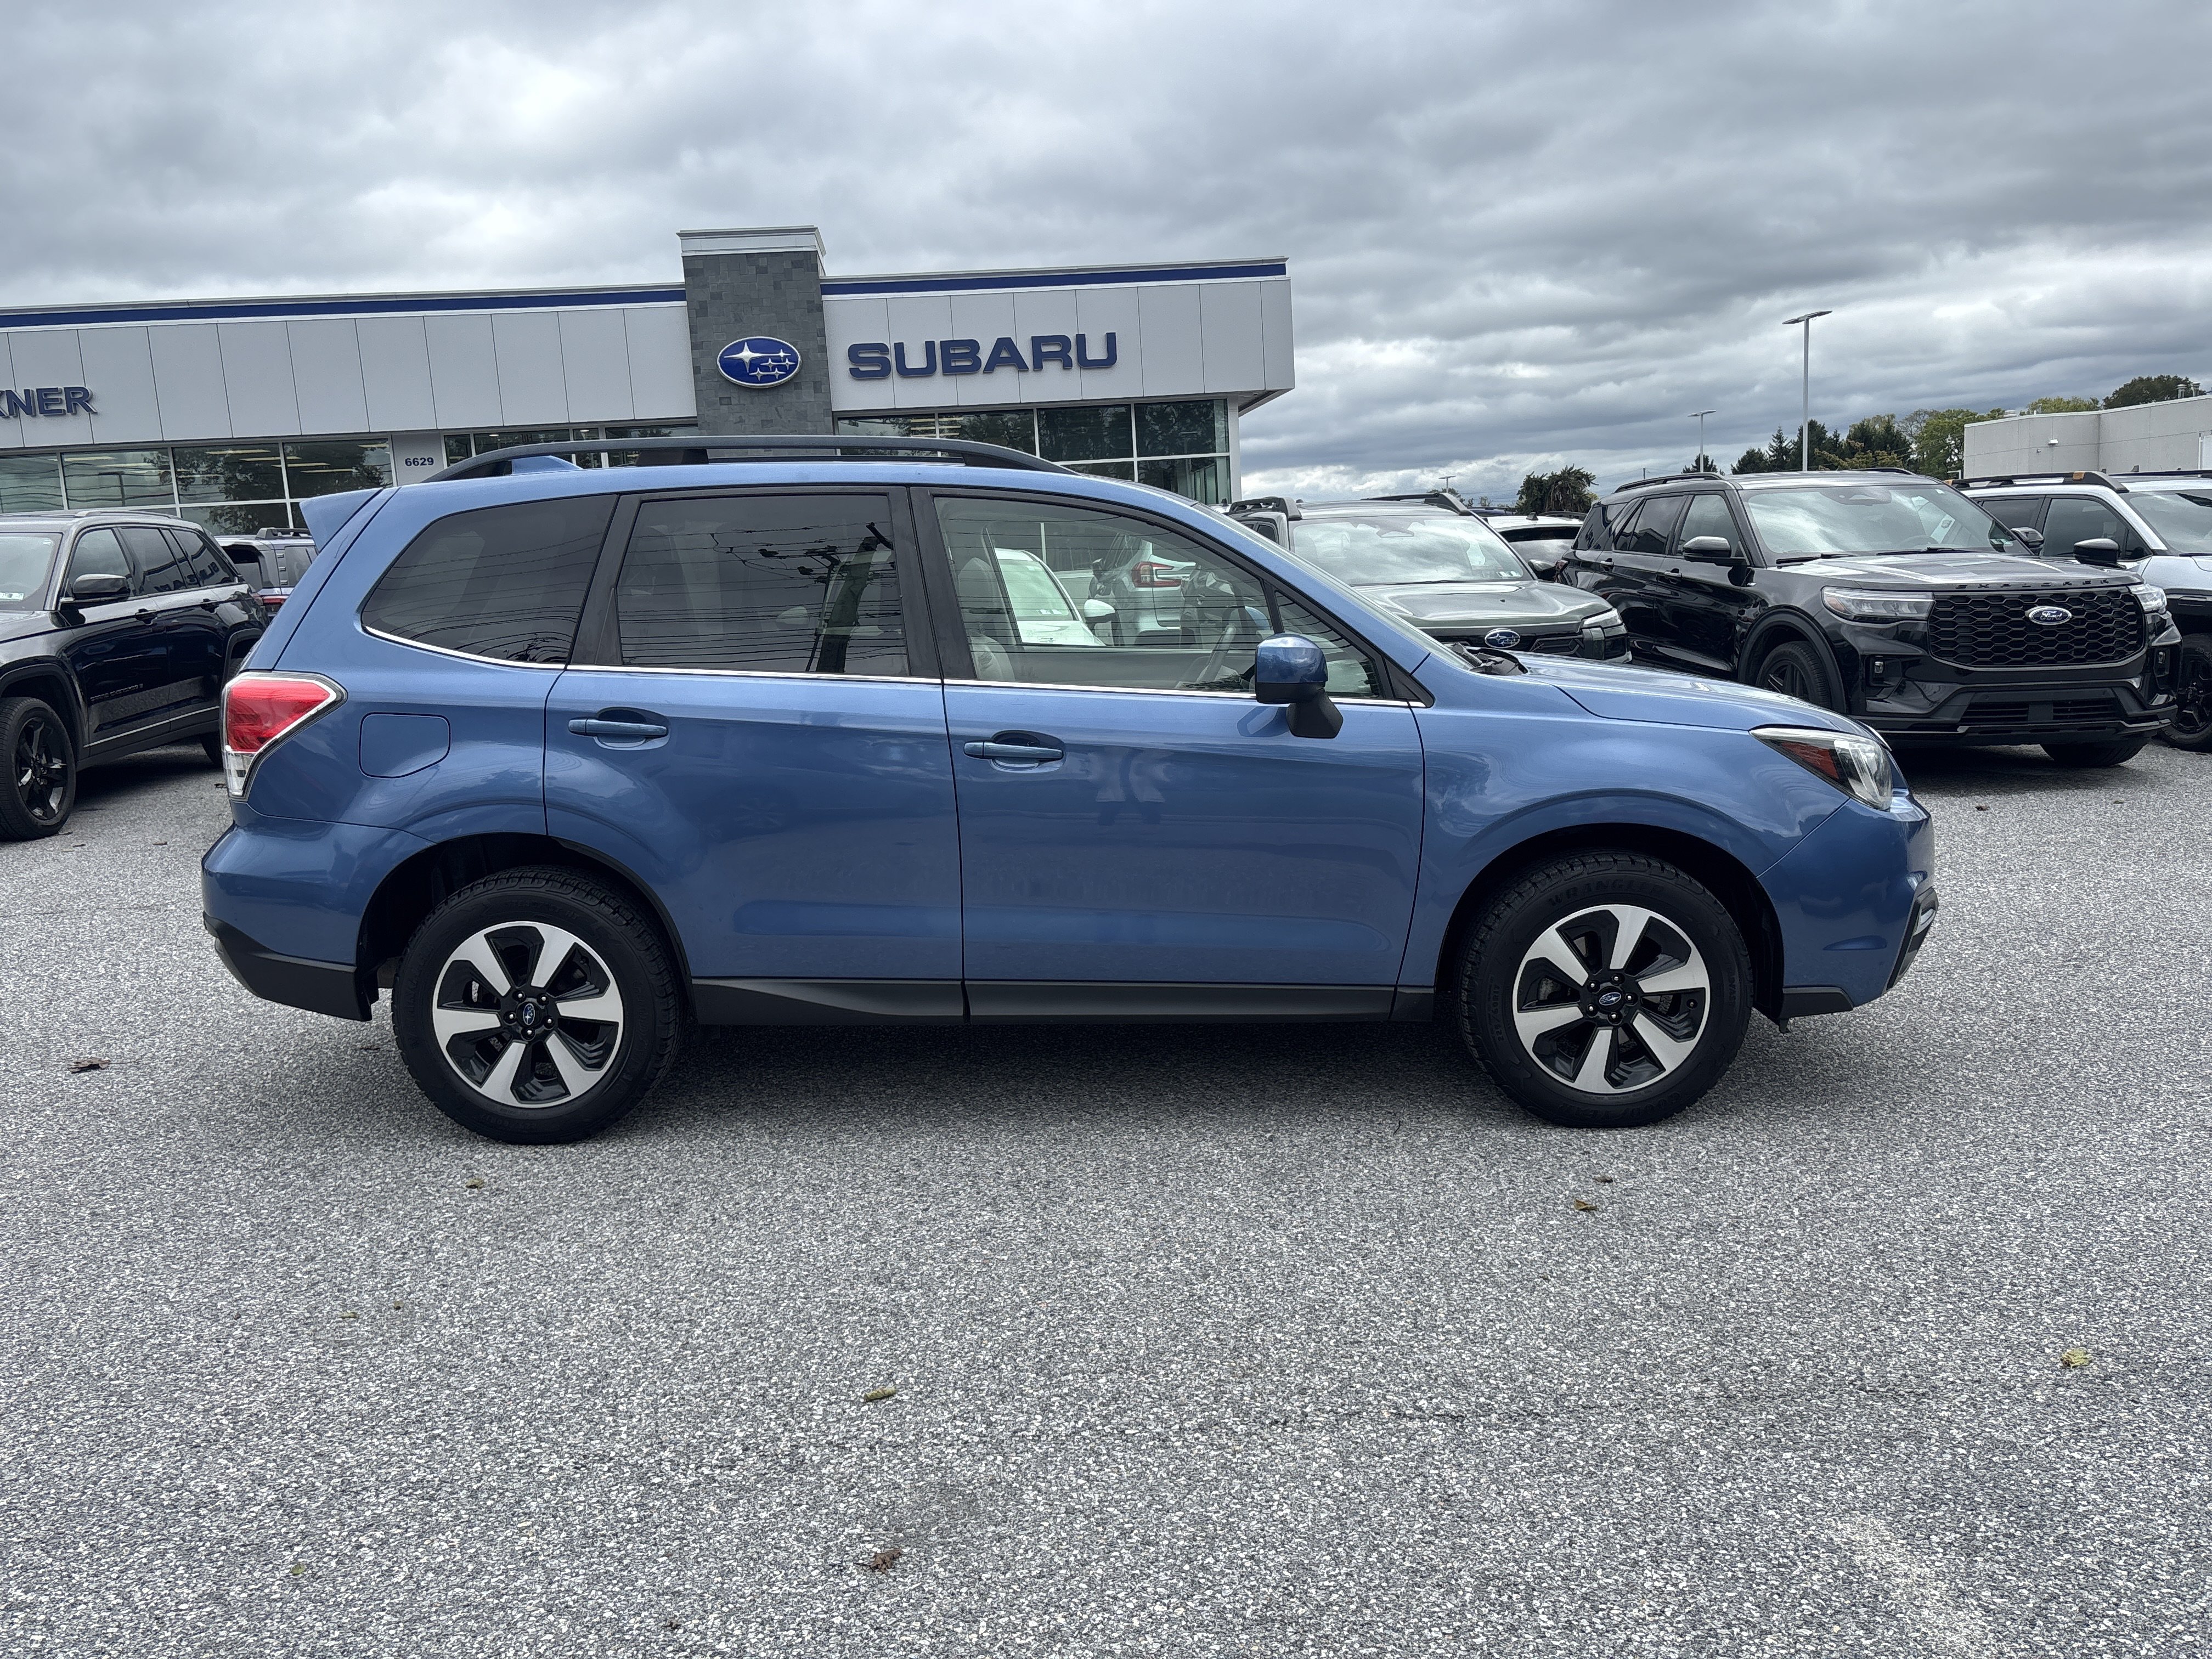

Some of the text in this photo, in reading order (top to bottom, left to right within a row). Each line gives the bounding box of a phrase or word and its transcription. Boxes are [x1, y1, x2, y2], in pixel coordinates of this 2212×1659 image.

[848, 332, 1118, 379] SUBARU
[405, 457, 434, 466] 6629
[1955, 579, 2109, 589] EXPLORER
[2040, 611, 2063, 620] Ford
